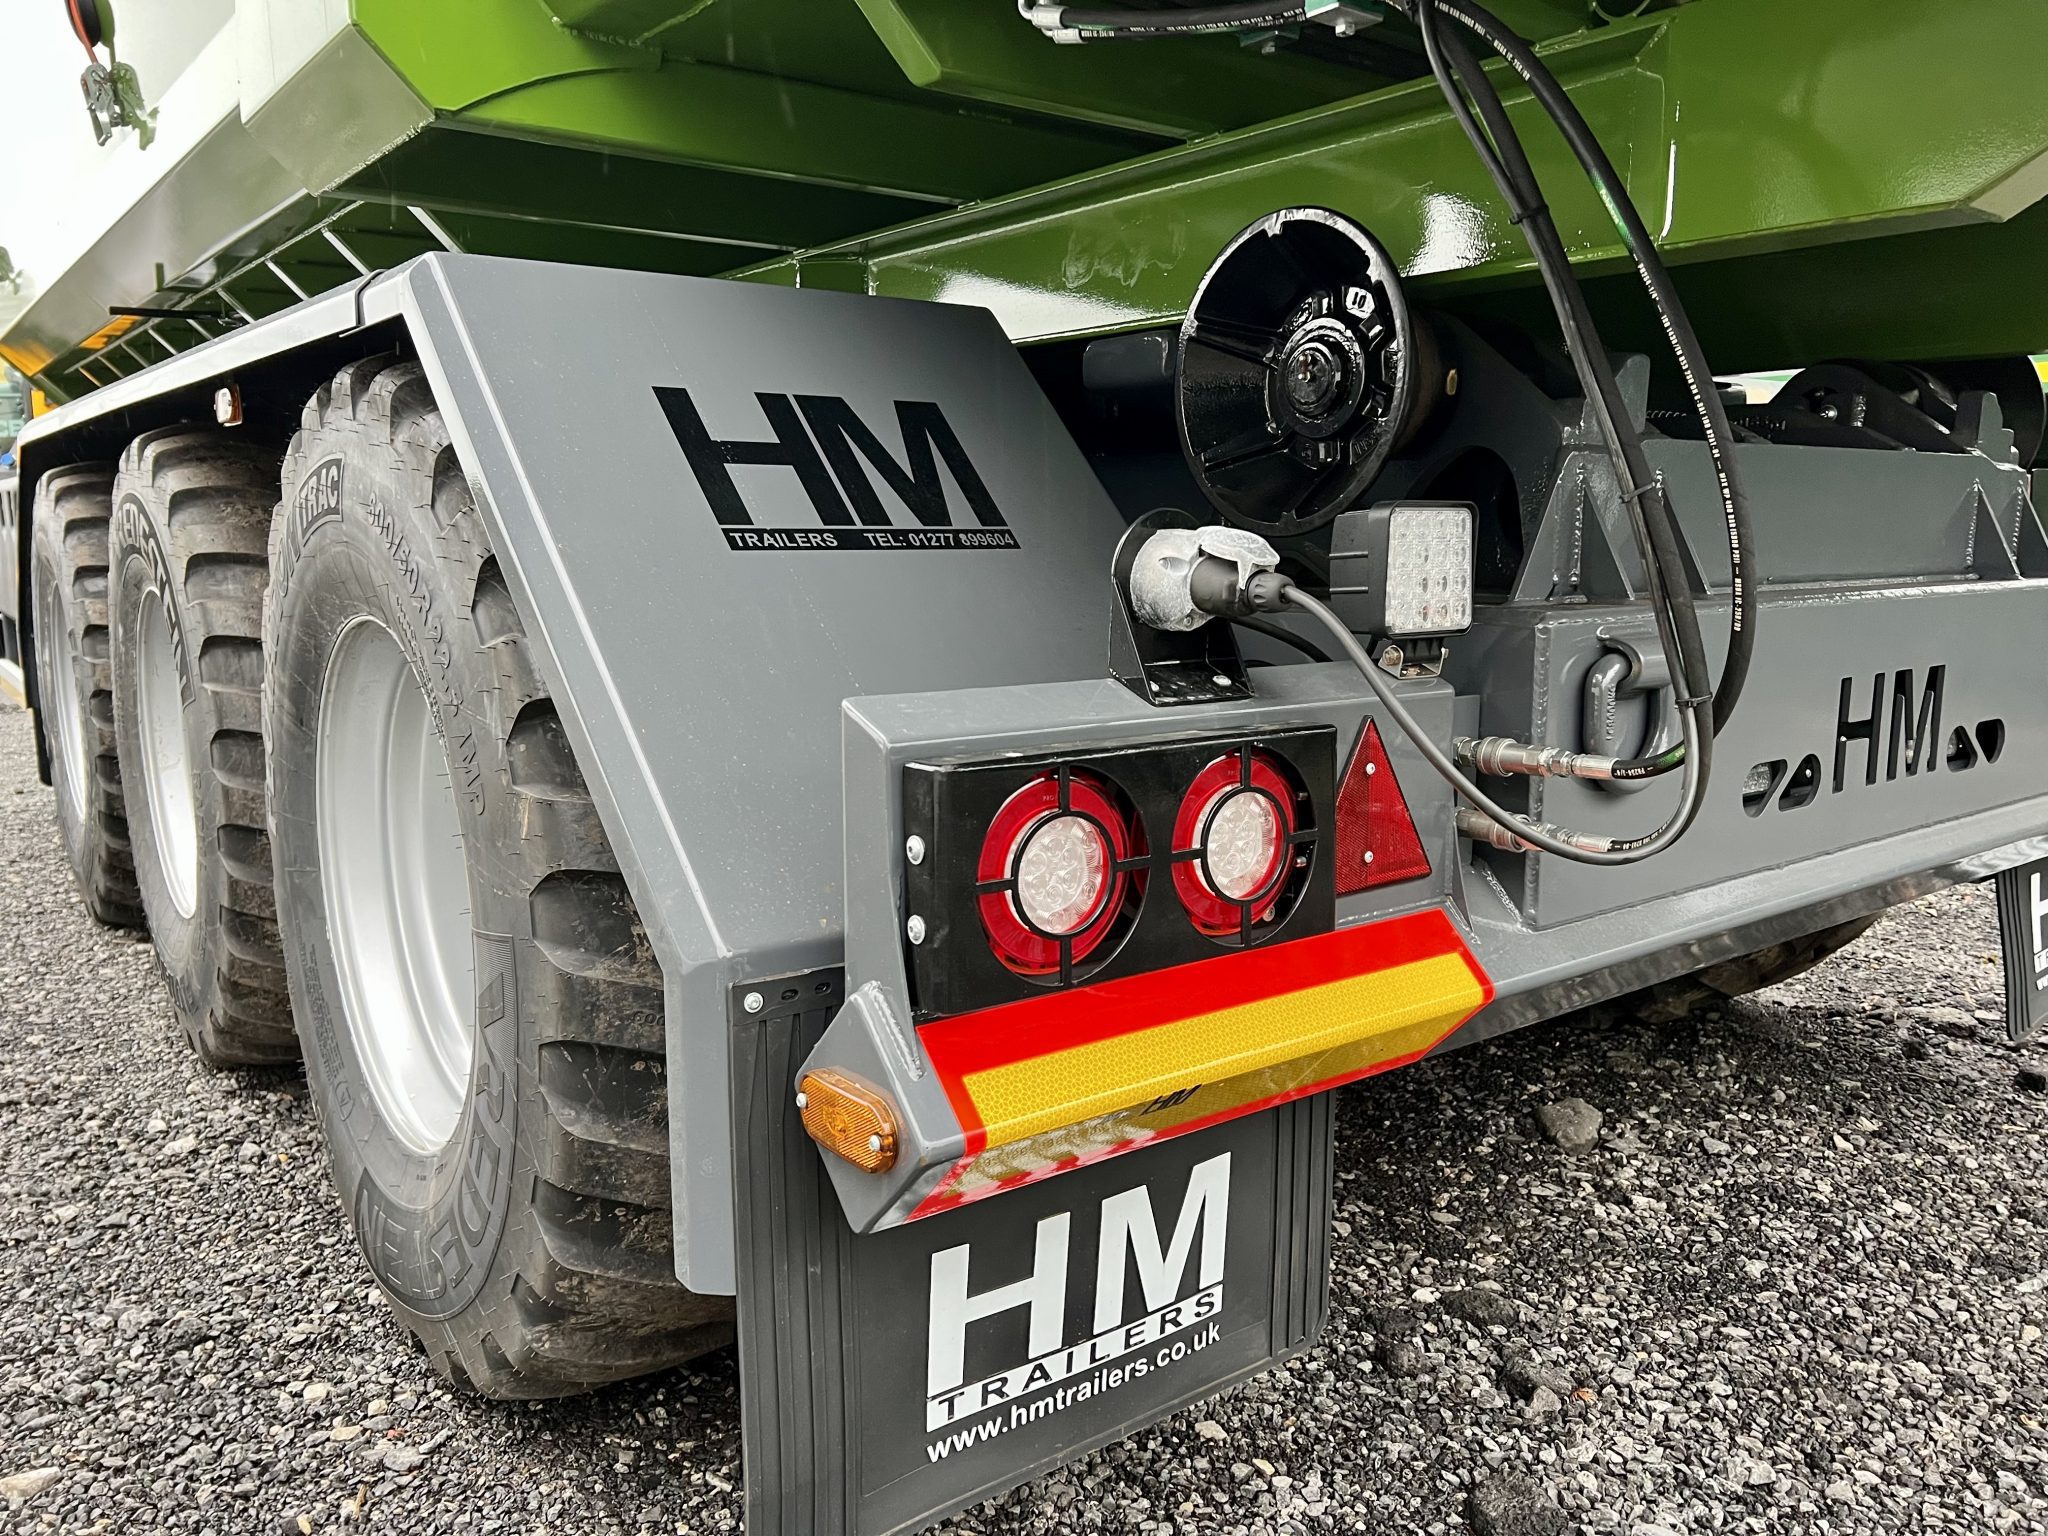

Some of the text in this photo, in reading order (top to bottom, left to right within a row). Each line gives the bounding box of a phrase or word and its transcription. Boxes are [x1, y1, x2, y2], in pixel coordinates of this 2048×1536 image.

[299, 465, 338, 529] TRAC
[651, 386, 1008, 526] HM
[729, 532, 1014, 548] TRAILERS TEL: 01277 899604
[1833, 664, 1947, 794] HM
[1140, 1083, 1204, 1117] HM
[927, 1151, 1232, 1398] HM
[927, 1322, 1221, 1465] www.hmtrailers.co.uk
[939, 1290, 1217, 1422] TRAILERS
